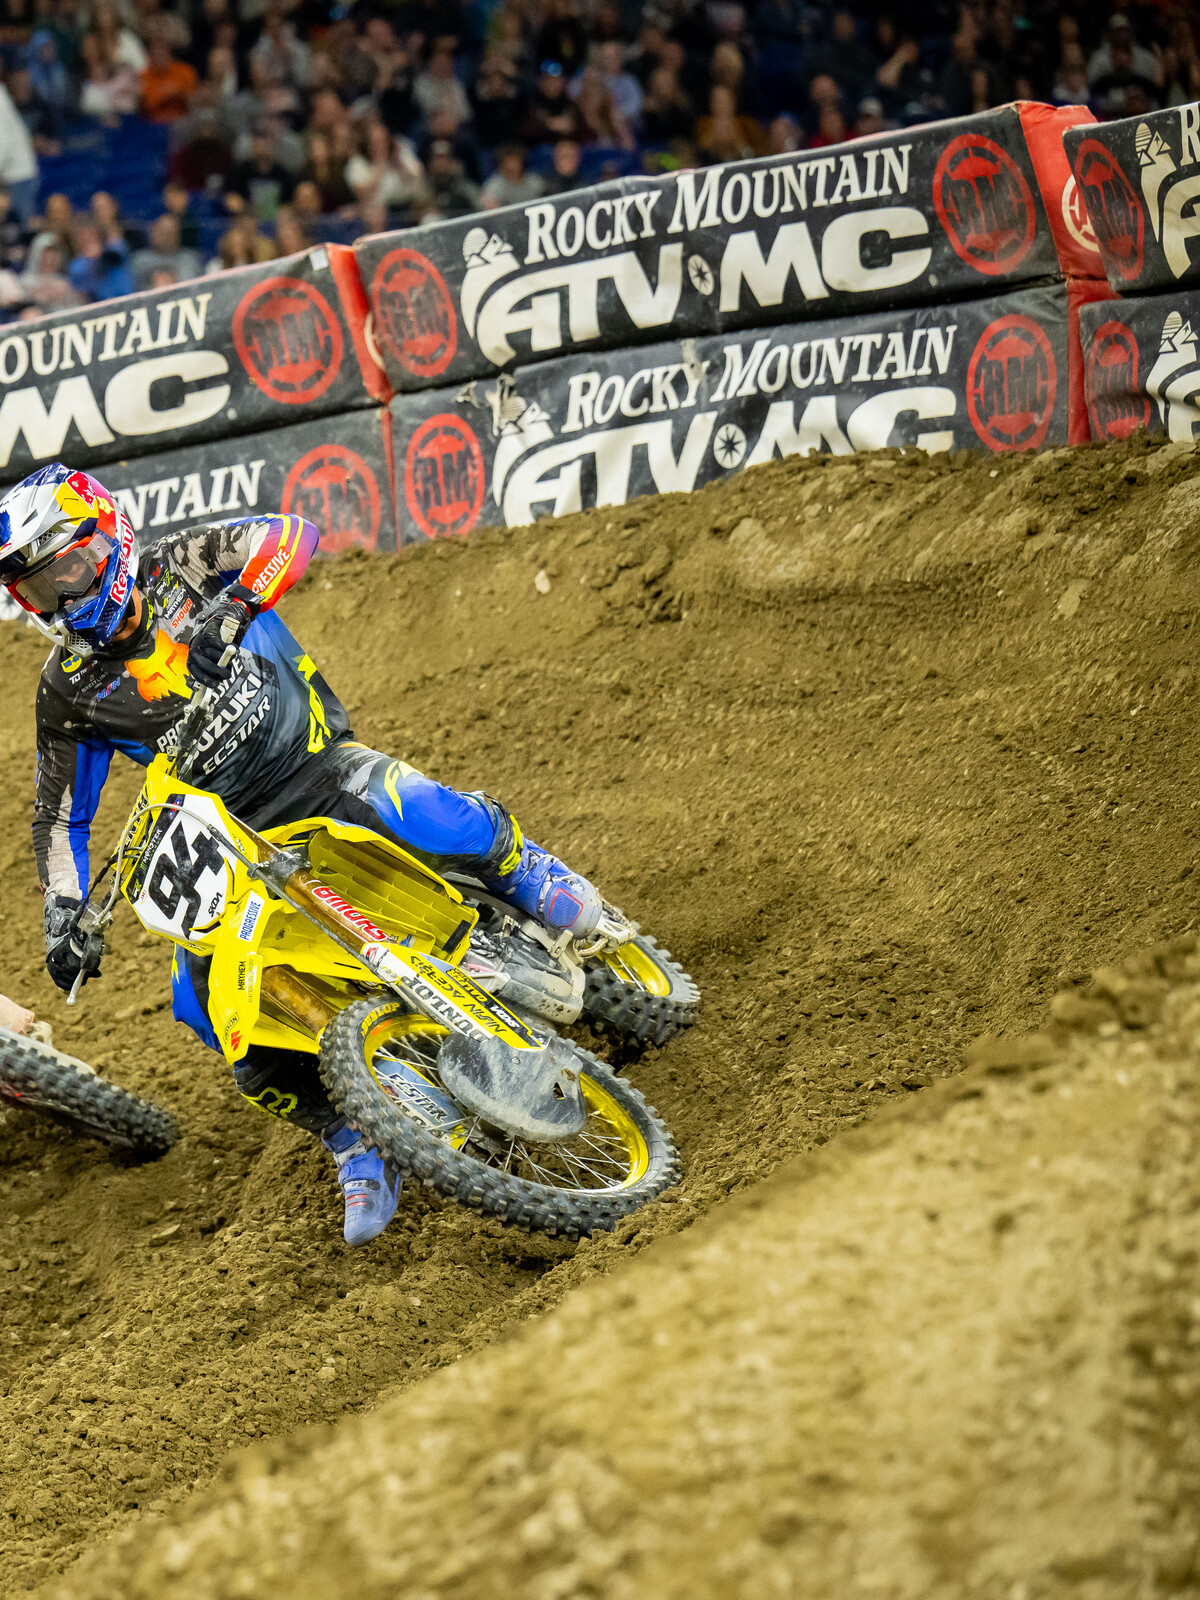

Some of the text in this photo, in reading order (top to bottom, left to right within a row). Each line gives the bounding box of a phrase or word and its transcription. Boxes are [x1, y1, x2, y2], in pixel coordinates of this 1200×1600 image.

[523, 144, 912, 265] ROCKY MOUNTAIN
[561, 325, 958, 433] ROCKY MOUNTAIN
[117, 459, 266, 532] NTAIN
[164, 588, 187, 619] MAYHEM
[171, 598, 193, 630] SHOWA
[202, 695, 272, 776] ECSTAR
[149, 820, 226, 940] 94
[240, 900, 261, 940] PROGRESSIVE
[311, 885, 389, 942] SHOWA
[238, 961, 246, 990] MAYHEM
[361, 1002, 400, 1038] DUNLOP
[401, 976, 489, 1042] DUNLOP
